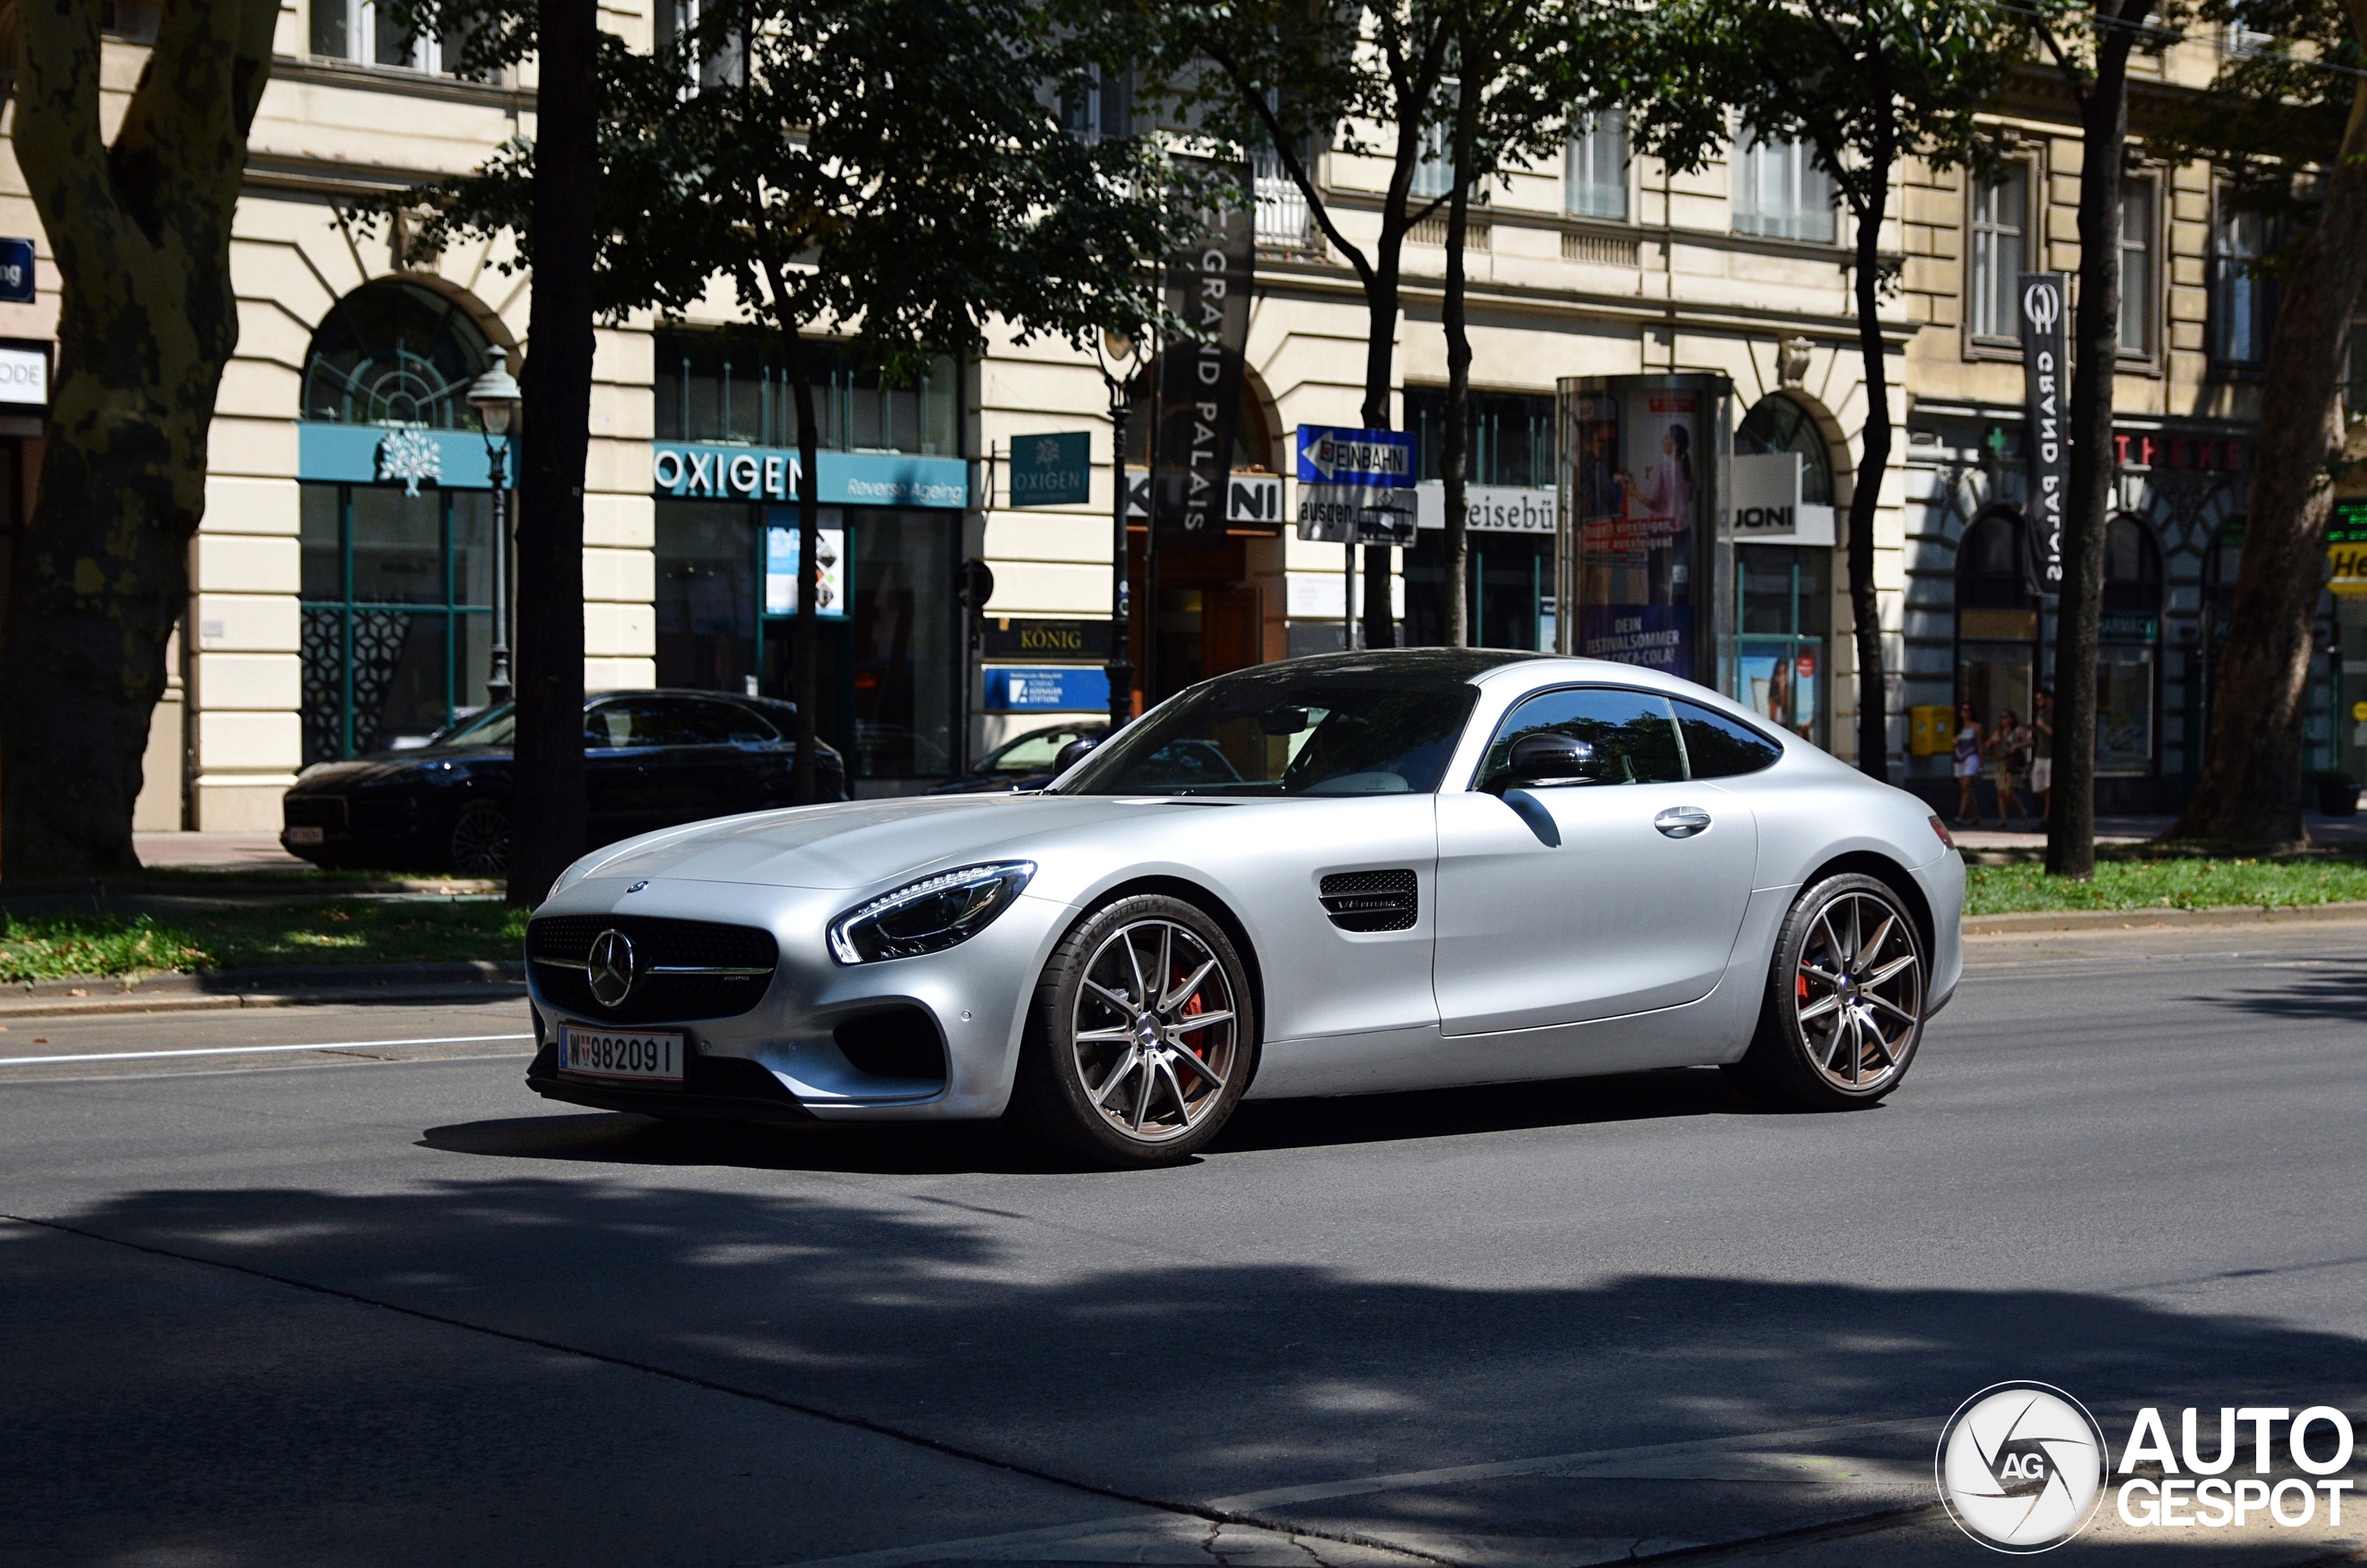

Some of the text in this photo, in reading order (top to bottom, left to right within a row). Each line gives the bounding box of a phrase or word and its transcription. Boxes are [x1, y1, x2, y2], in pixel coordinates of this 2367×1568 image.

[1183, 249, 1228, 532] GRAND PALAIS
[1335, 444, 1404, 472] EINBAHN
[2114, 435, 2242, 472] THEKE
[848, 478, 963, 506] Reverse Ageing
[1013, 471, 1080, 491] OXIGEN
[1125, 478, 1276, 521] KNI
[1301, 502, 1357, 529] ausgen.
[1467, 495, 1554, 529] eisebü
[1614, 617, 1642, 634] DEIN
[1094, 900, 1149, 937] MICHELIN
[570, 1033, 581, 1066] W
[591, 1036, 657, 1072] 98209
